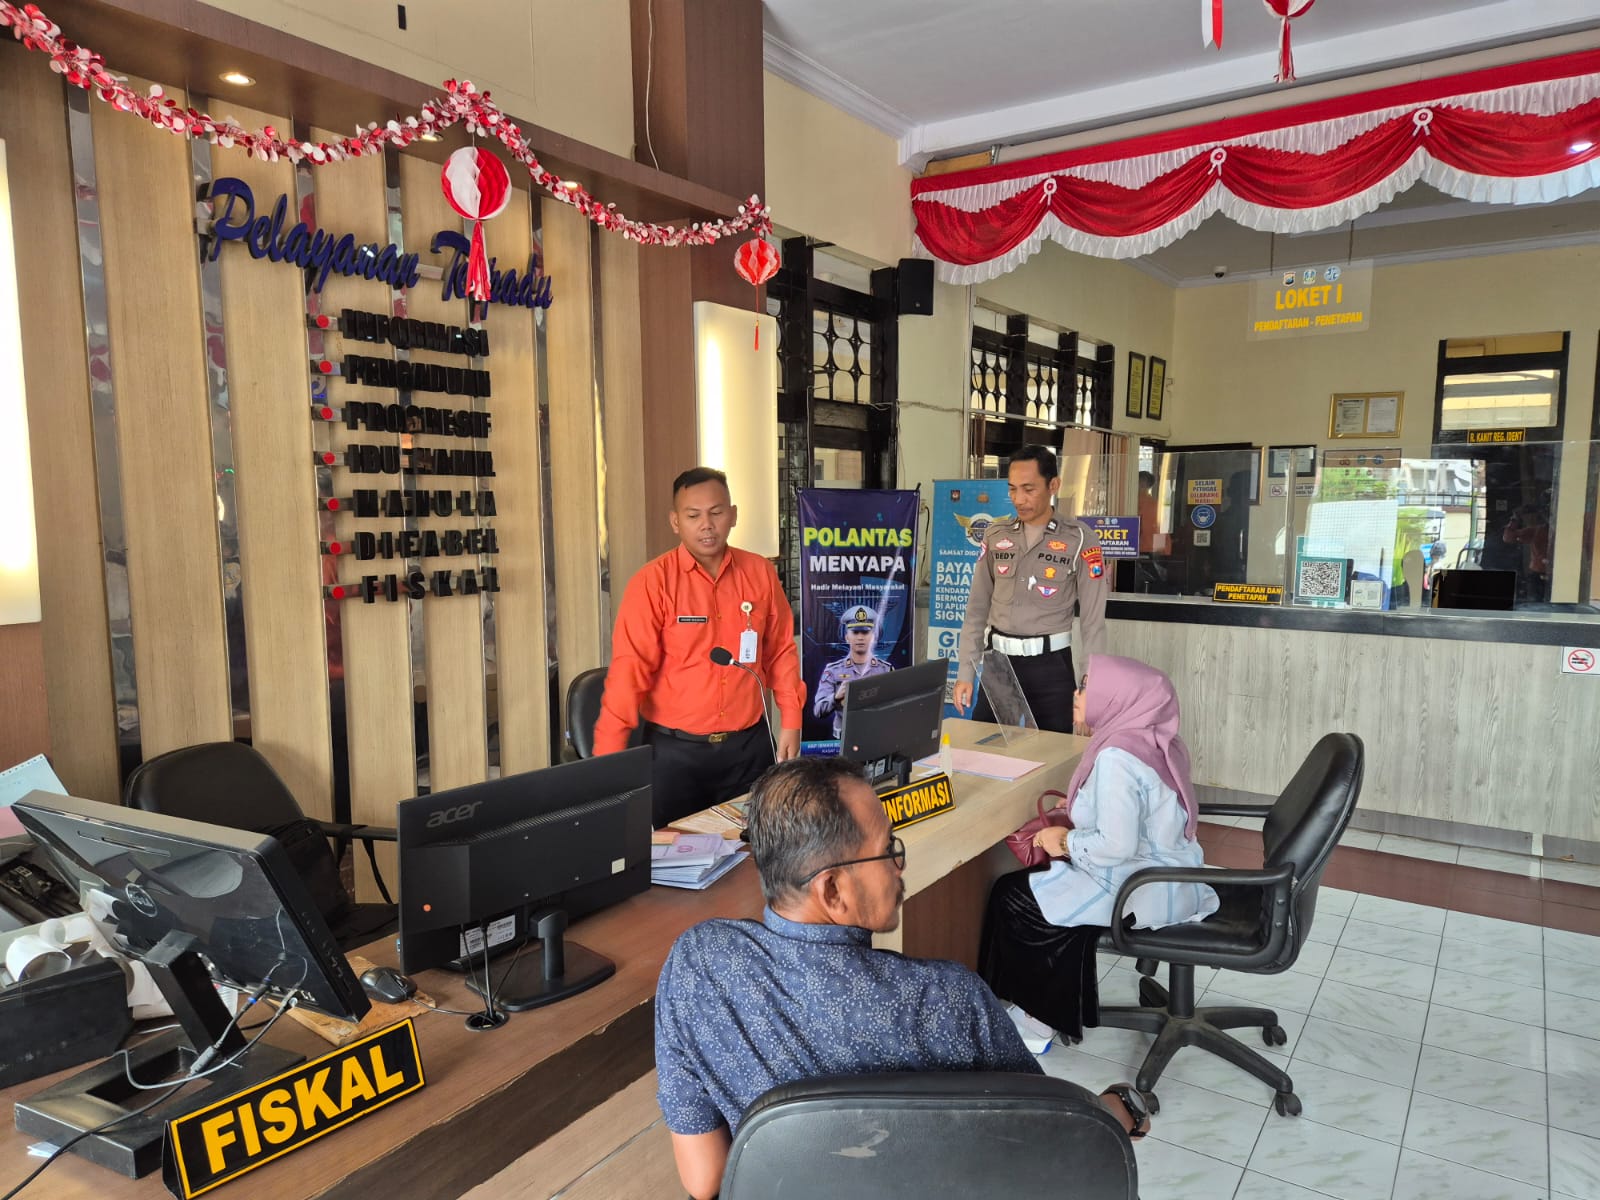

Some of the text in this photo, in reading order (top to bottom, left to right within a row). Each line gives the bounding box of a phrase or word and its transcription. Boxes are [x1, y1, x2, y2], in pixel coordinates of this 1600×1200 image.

[208, 177, 421, 294] Pelayanan
[1275, 284, 1332, 310] LOKET
[1254, 317, 1310, 332] PENDAFTARAN
[1315, 312, 1363, 327] PENETAPAN
[342, 308, 490, 357] INFORMASI
[344, 354, 491, 398] PENGADUAN
[345, 400, 493, 438] PROGRESIF
[1507, 431, 1523, 441] IDENT
[347, 444, 496, 477] IBU HAMIL
[803, 527, 913, 547] POLANTAS
[1094, 529, 1128, 540] OKET
[809, 555, 906, 573] MENYAPA
[936, 561, 976, 574] BAYA
[1038, 552, 1071, 566] POLRI
[362, 567, 500, 604] FISKAL
[811, 583, 905, 593] Hadir Melayani Masyarakat
[936, 574, 973, 586] PAJA
[935, 586, 970, 595] KENDARA
[935, 594, 968, 602] BERMOT
[1217, 584, 1282, 595] PENDAFTARAN DAN
[1228, 592, 1268, 602] PENETAPAN
[935, 610, 965, 621] SIGN
[938, 648, 959, 658] BIA
[882, 781, 950, 824] INFORMASI
[426, 800, 483, 828] acer
[201, 1044, 404, 1175] FISKAL
